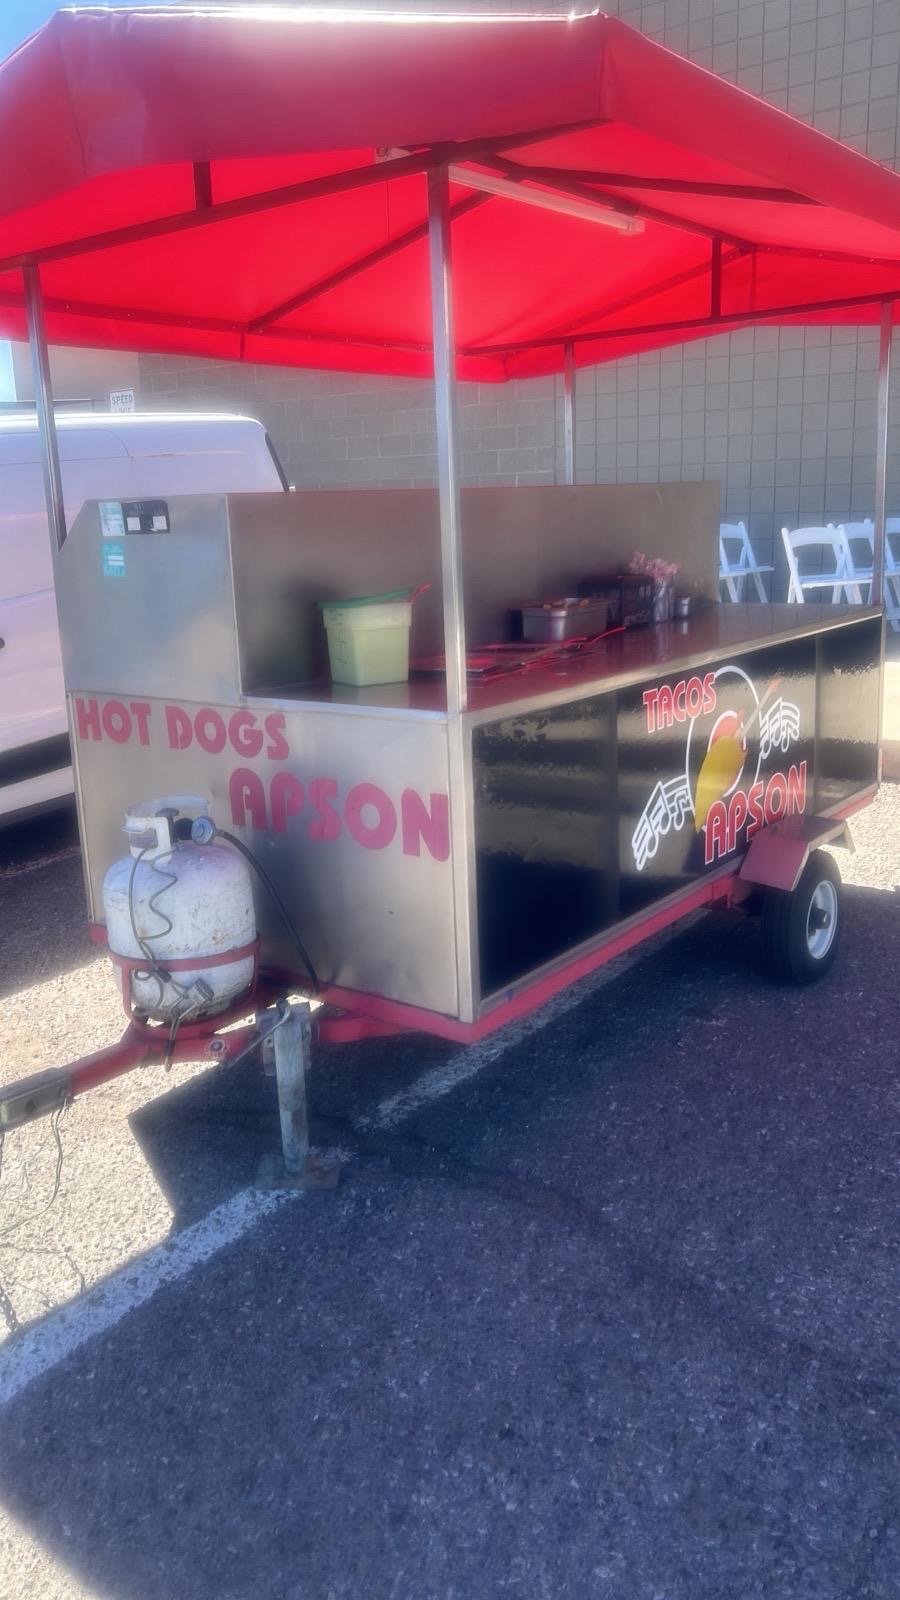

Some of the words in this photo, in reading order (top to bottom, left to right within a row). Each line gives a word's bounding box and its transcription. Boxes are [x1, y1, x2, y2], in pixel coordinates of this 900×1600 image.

[112, 394, 132, 405] SPEED
[75, 698, 151, 746] HOT
[165, 704, 290, 760] DOGS
[643, 672, 717, 733] TACOS
[228, 767, 450, 862] APSON
[704, 760, 808, 865] APSON
